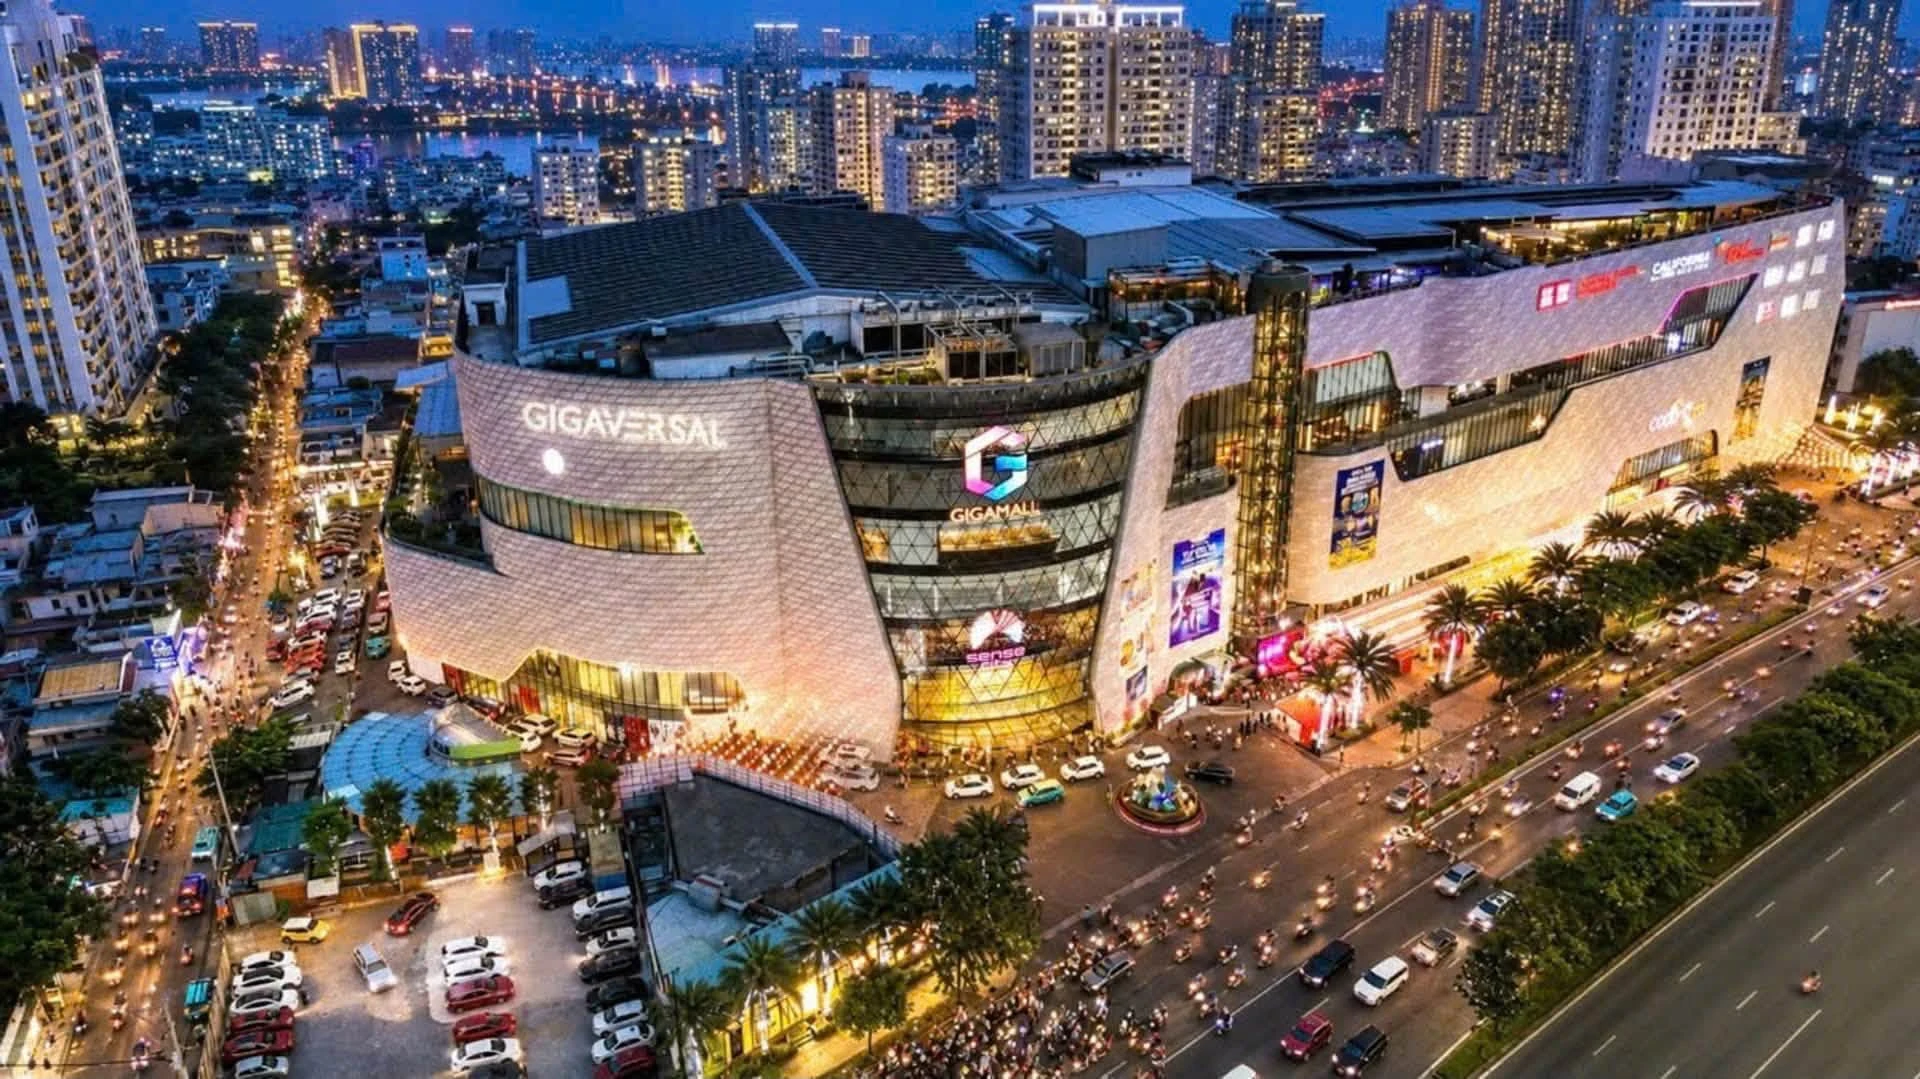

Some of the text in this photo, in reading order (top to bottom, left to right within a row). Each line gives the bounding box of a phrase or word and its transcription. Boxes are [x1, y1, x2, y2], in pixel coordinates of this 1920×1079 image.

[522, 402, 728, 449] GIGAVERSAL
[950, 501, 1040, 522] GIGAMALL
[966, 646, 1025, 662] sense
